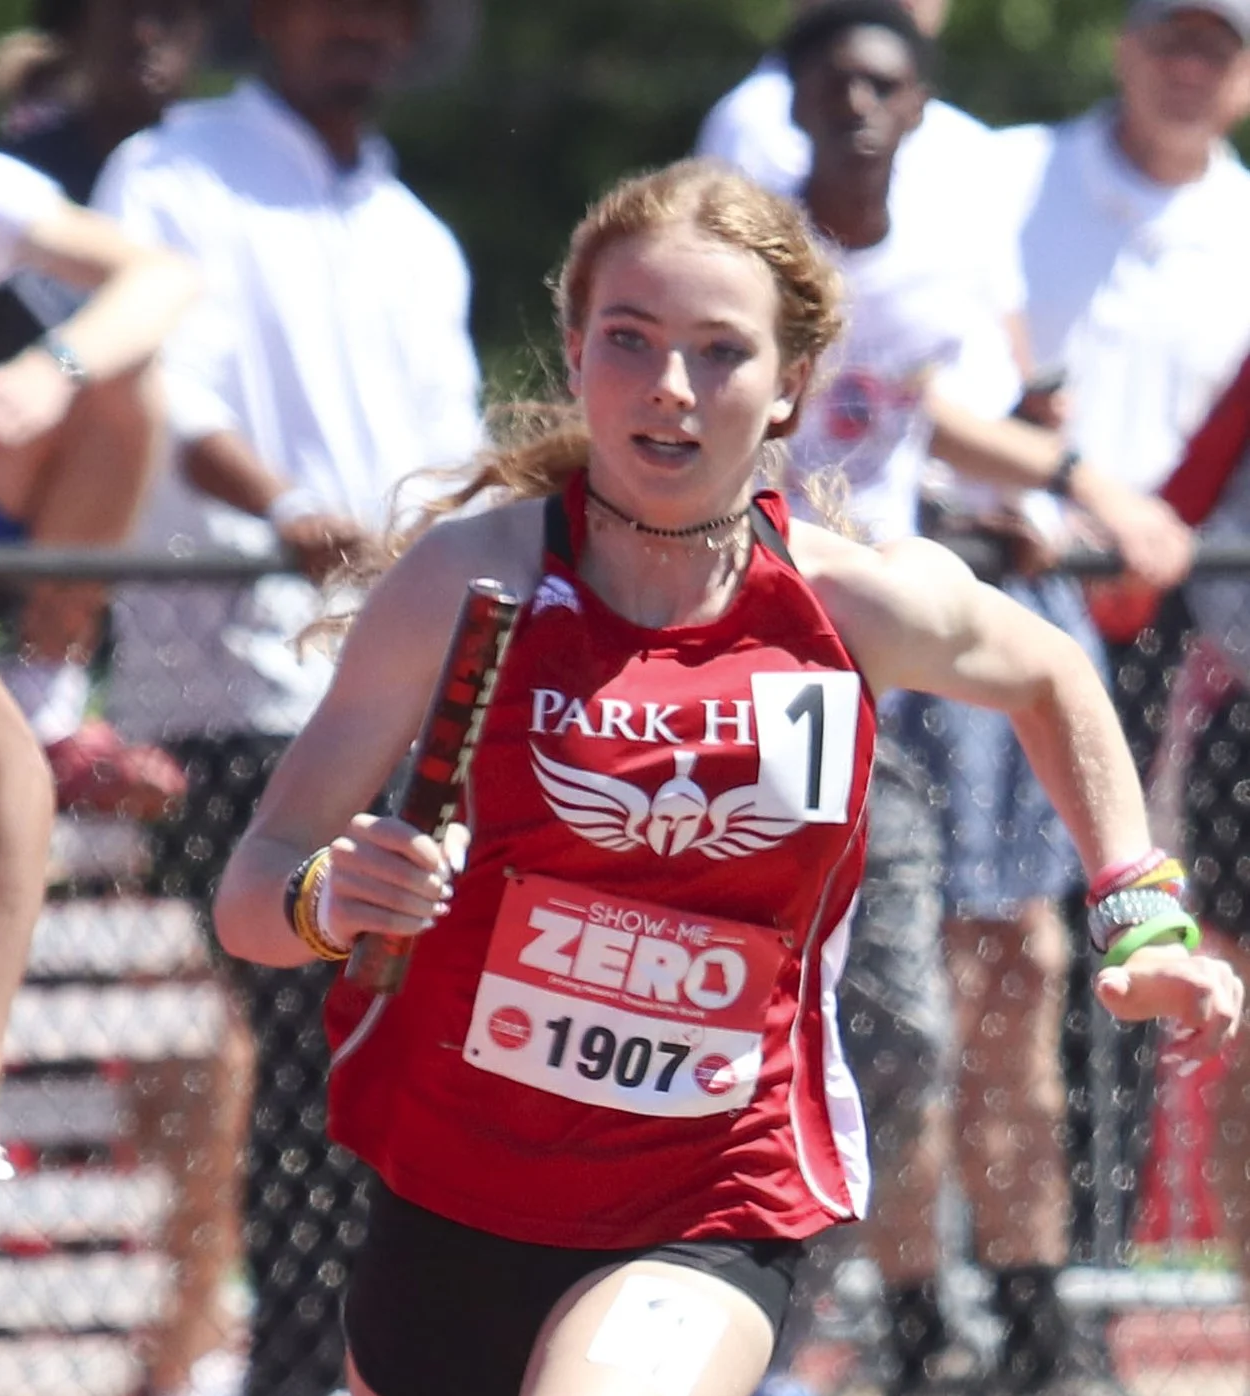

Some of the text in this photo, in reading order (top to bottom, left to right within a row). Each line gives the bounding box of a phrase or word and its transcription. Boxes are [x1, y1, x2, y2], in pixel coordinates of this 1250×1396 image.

[528, 688, 756, 747] PARK H
[784, 683, 824, 810] 1
[518, 906, 748, 1010] ZERO
[588, 901, 714, 948] SHOW-ME
[545, 1015, 692, 1093] 1907
